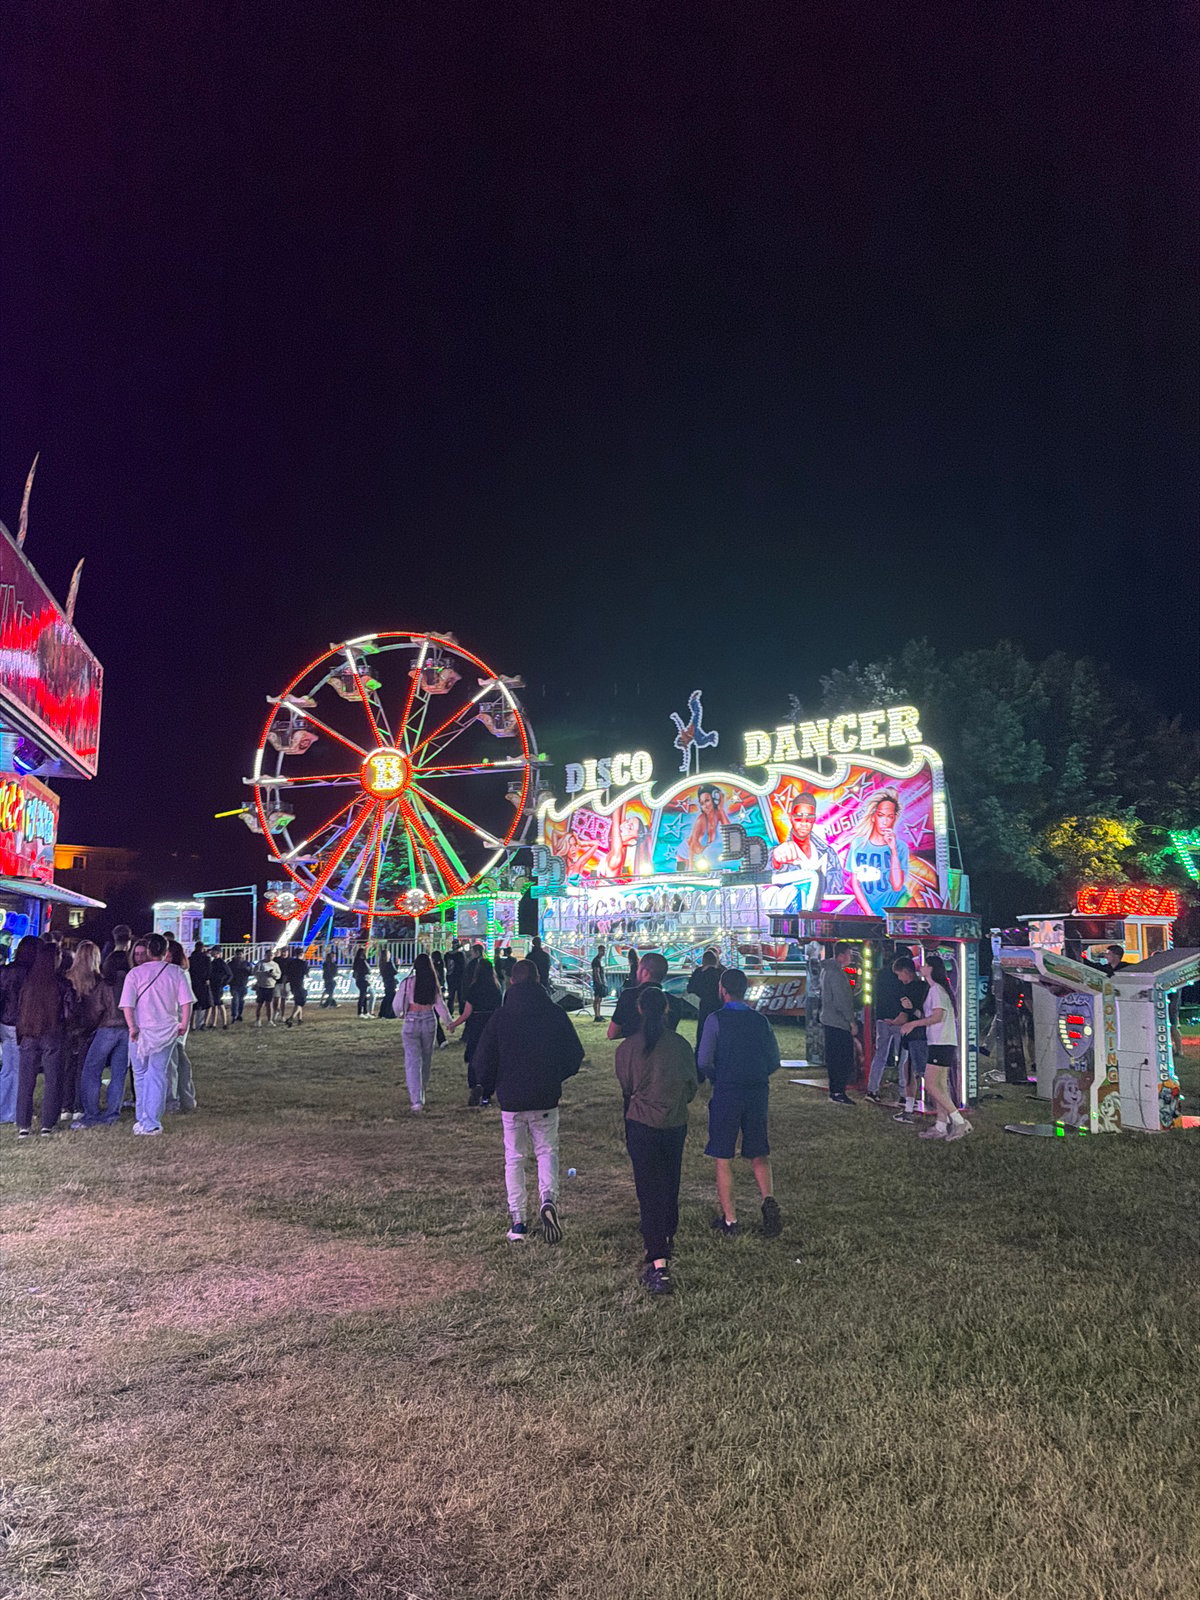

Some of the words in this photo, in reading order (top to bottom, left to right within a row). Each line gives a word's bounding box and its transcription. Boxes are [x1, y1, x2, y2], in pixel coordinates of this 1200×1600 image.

[565, 750, 653, 793] DISCO
[743, 706, 923, 767] DANCER
[1079, 886, 1179, 916] CASSA
[967, 951, 977, 1047] TOURNAMENT
[1155, 983, 1168, 1019] KIDS
[1103, 983, 1119, 1082] BOXING
[1157, 1025, 1169, 1081] BOXING
[968, 1051, 978, 1099] BOXER
